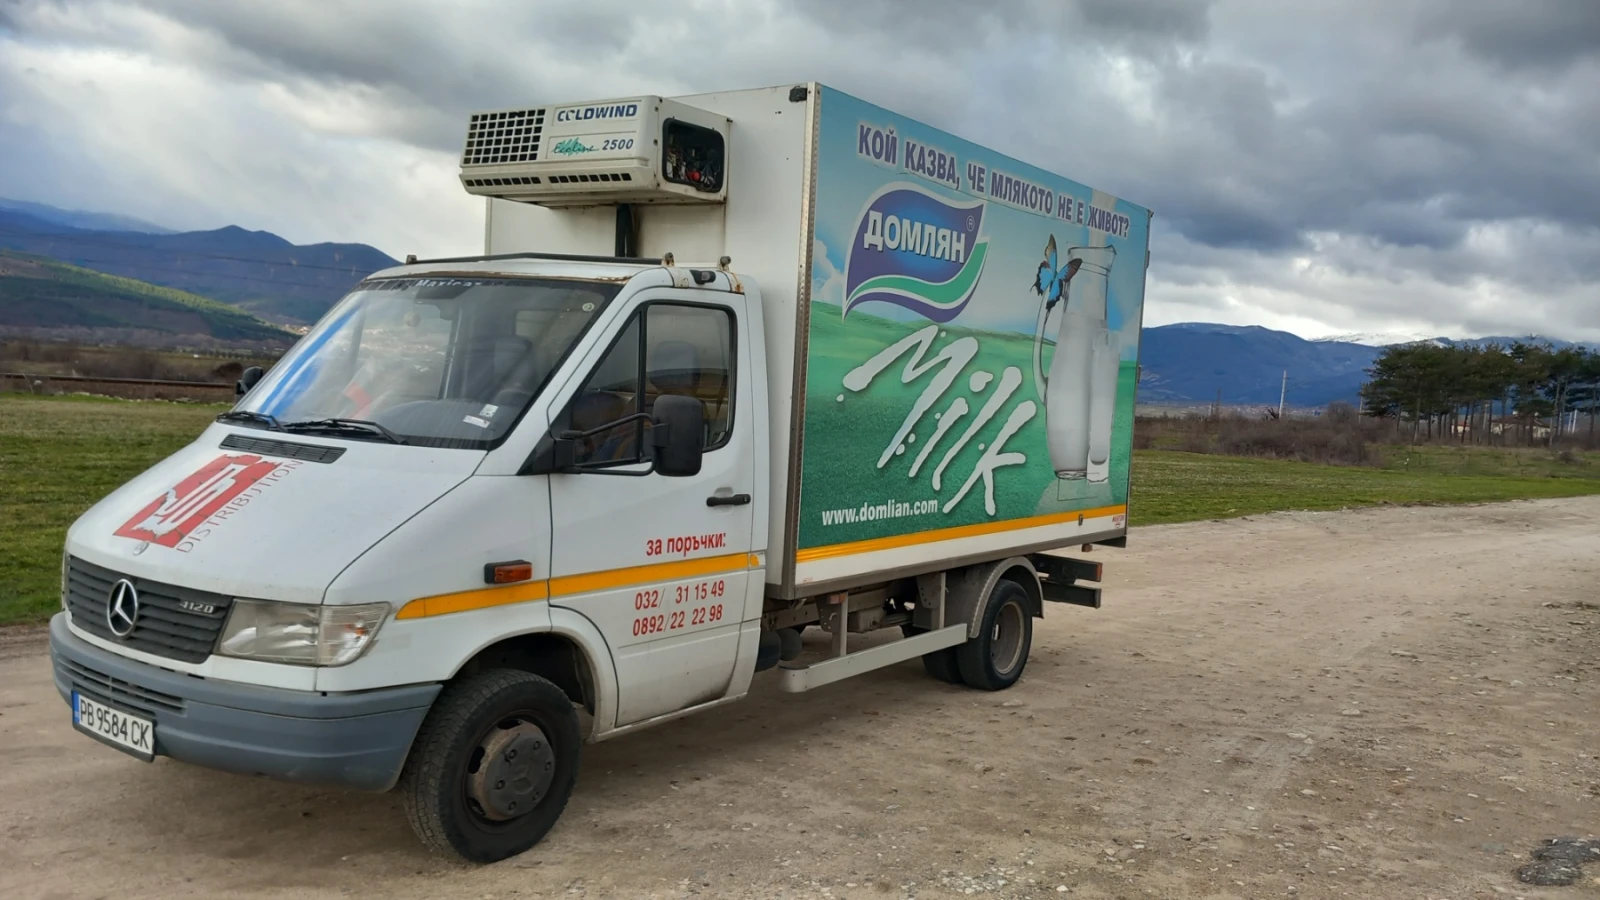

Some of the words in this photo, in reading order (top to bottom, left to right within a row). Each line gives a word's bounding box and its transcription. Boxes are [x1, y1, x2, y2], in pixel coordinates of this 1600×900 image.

[557, 104, 638, 122] COLDWIND
[602, 139, 634, 151] 2500
[858, 124, 898, 165] КОЙ
[904, 141, 960, 190] КАЗВА,
[967, 163, 986, 193] ЧЕ
[990, 172, 1053, 214] МЛЯКОТО
[1057, 195, 1073, 220] НЕ
[1076, 202, 1084, 224] Е
[1087, 205, 1130, 237] ЖИВОТ?
[863, 210, 966, 265] ДОМЛЯН
[842, 324, 1037, 516] Milk
[176, 460, 303, 553] DISTRIBUTION
[821, 499, 938, 526] www.domlian.com
[646, 539, 662, 556] за
[666, 532, 727, 557] поръчки:
[635, 588, 666, 611] 032/
[675, 585, 689, 604] 31
[694, 582, 708, 600] 15
[711, 580, 725, 597] 49
[691, 607, 706, 626] 22
[709, 604, 723, 622] 98
[80, 699, 95, 727] PB
[96, 707, 128, 742] 9584
[131, 720, 150, 750] CK
